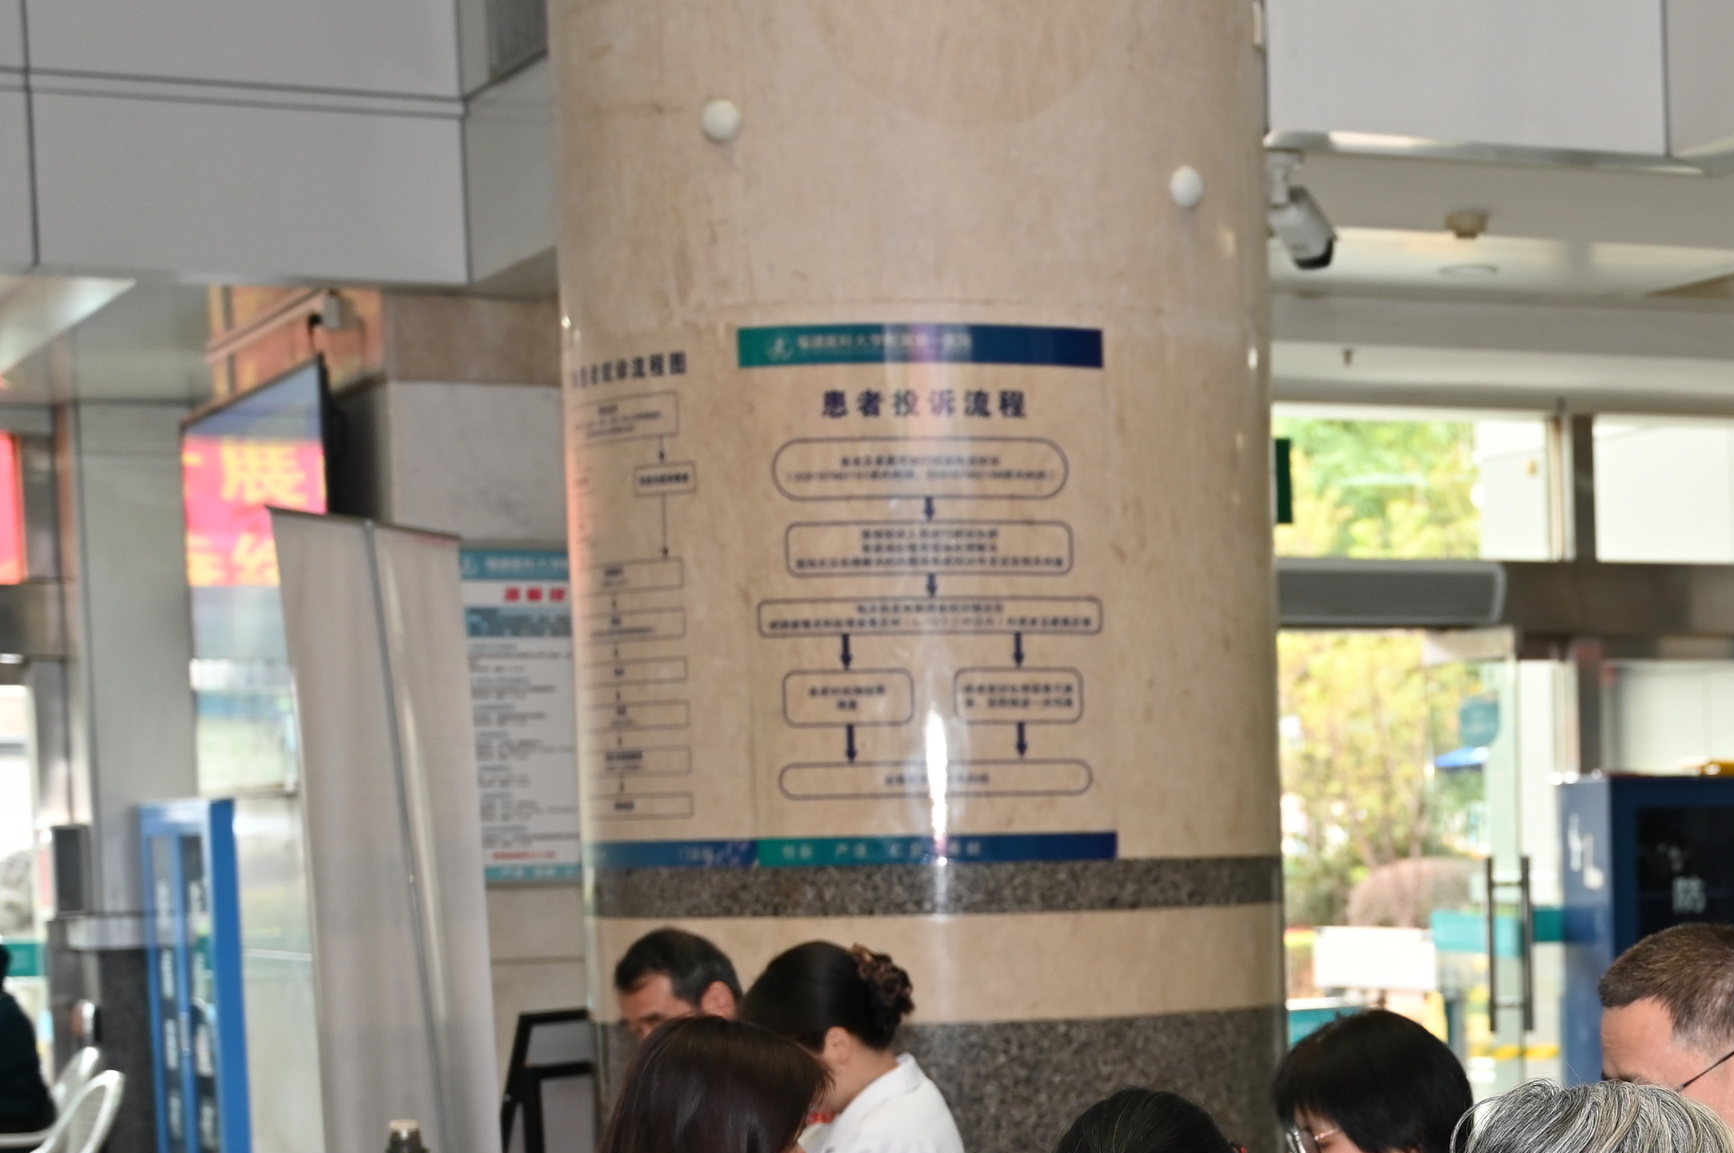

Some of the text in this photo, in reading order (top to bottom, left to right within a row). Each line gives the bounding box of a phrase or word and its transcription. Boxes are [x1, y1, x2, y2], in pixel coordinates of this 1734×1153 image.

[822, 389, 1027, 419] 患者投诉流程
